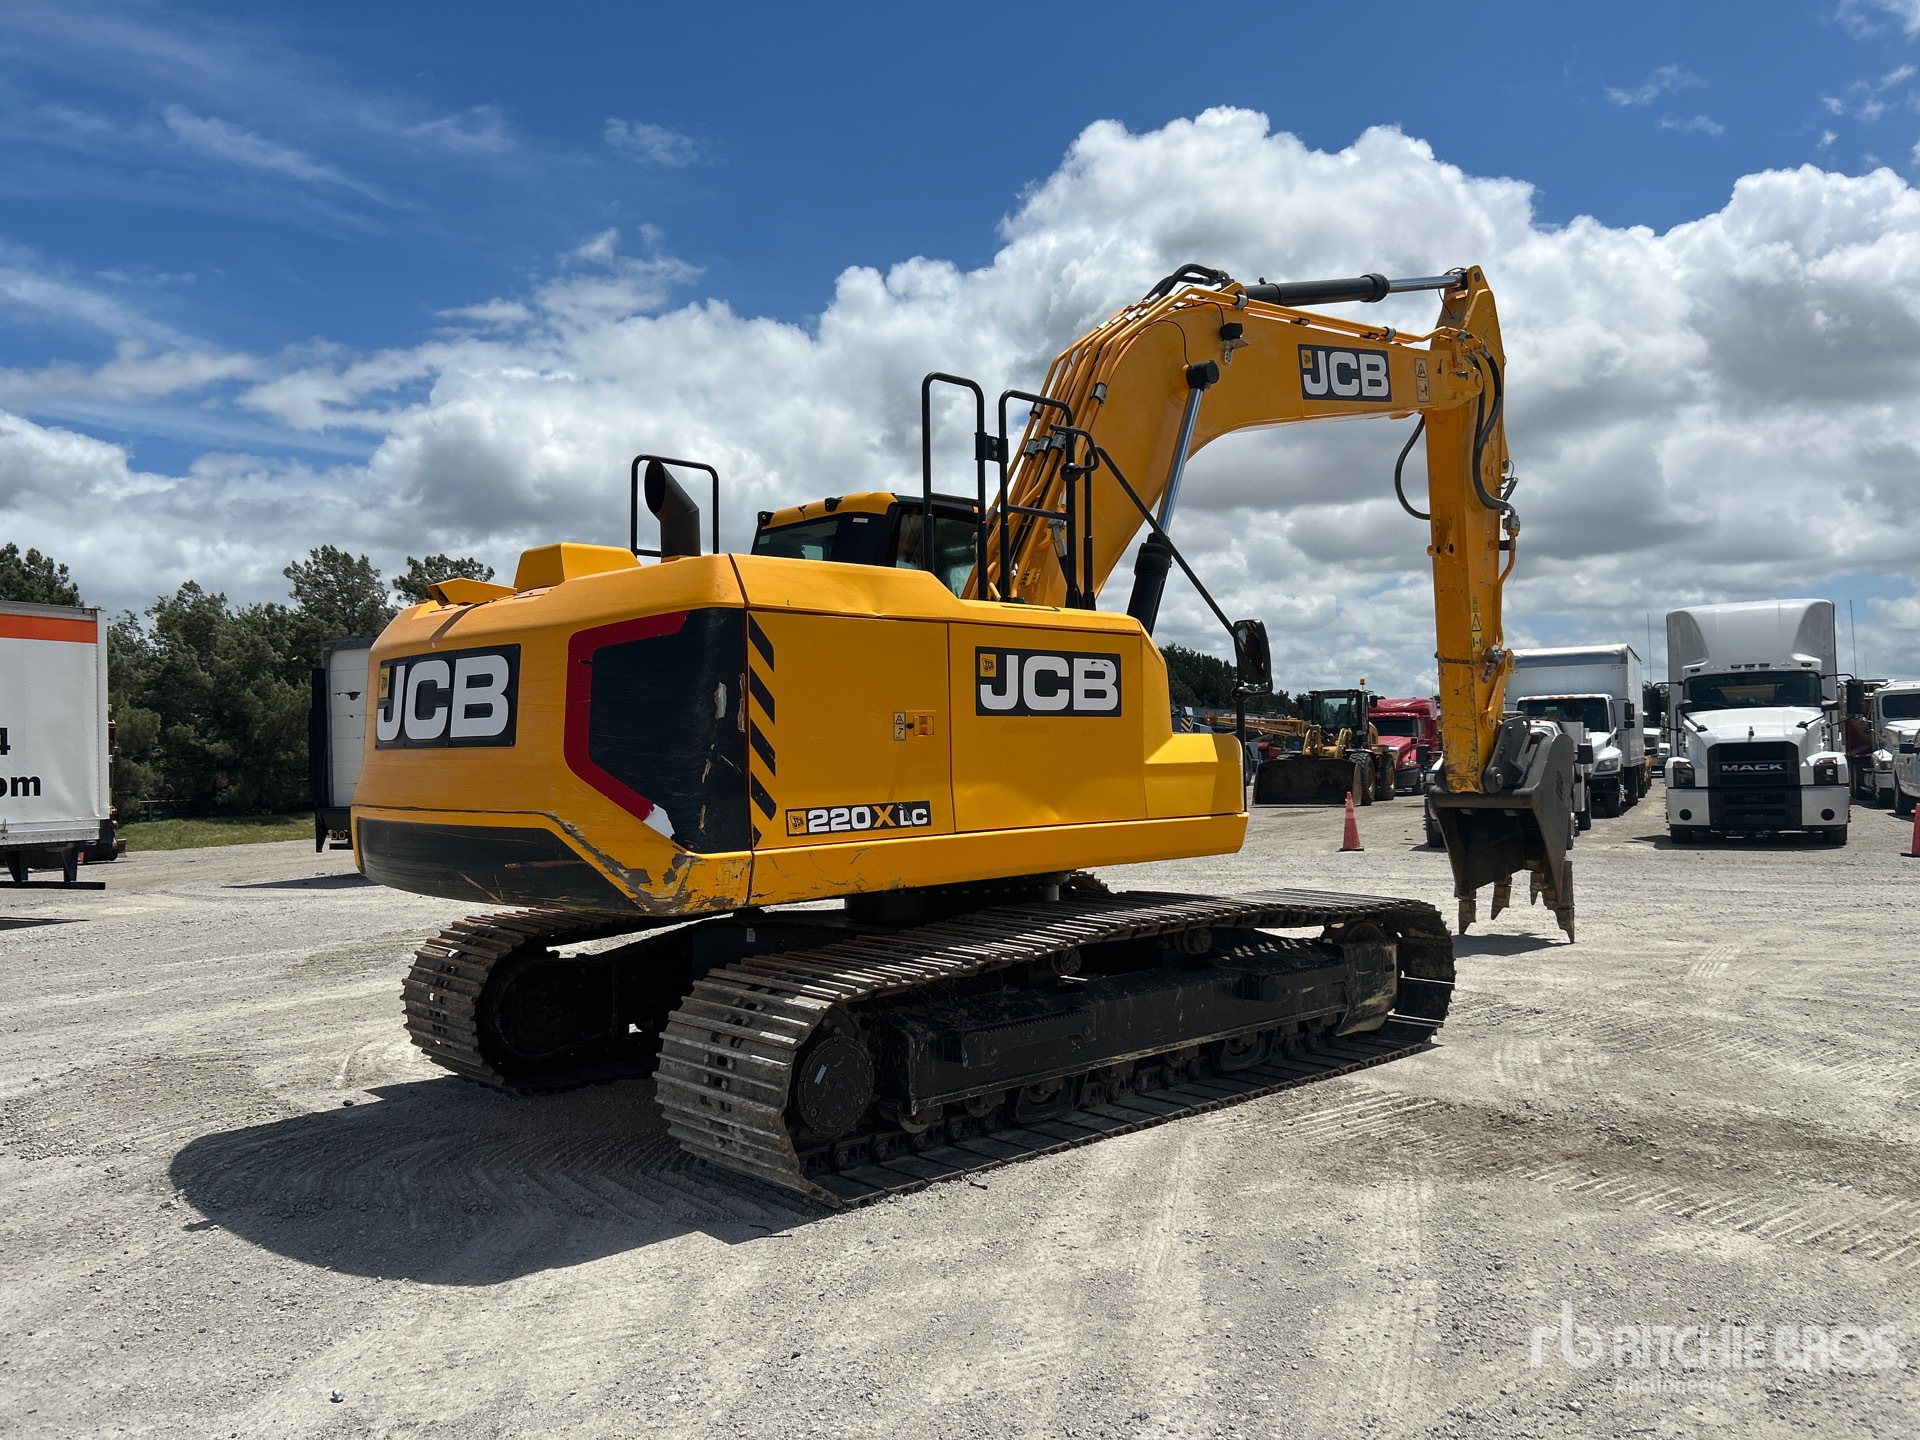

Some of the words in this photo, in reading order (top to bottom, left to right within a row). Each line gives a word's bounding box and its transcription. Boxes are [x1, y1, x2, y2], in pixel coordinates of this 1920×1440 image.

[1303, 350, 1389, 397] JCB
[377, 654, 509, 741] JCB
[980, 654, 1119, 711] JCB
[1721, 763, 1784, 772] MACK
